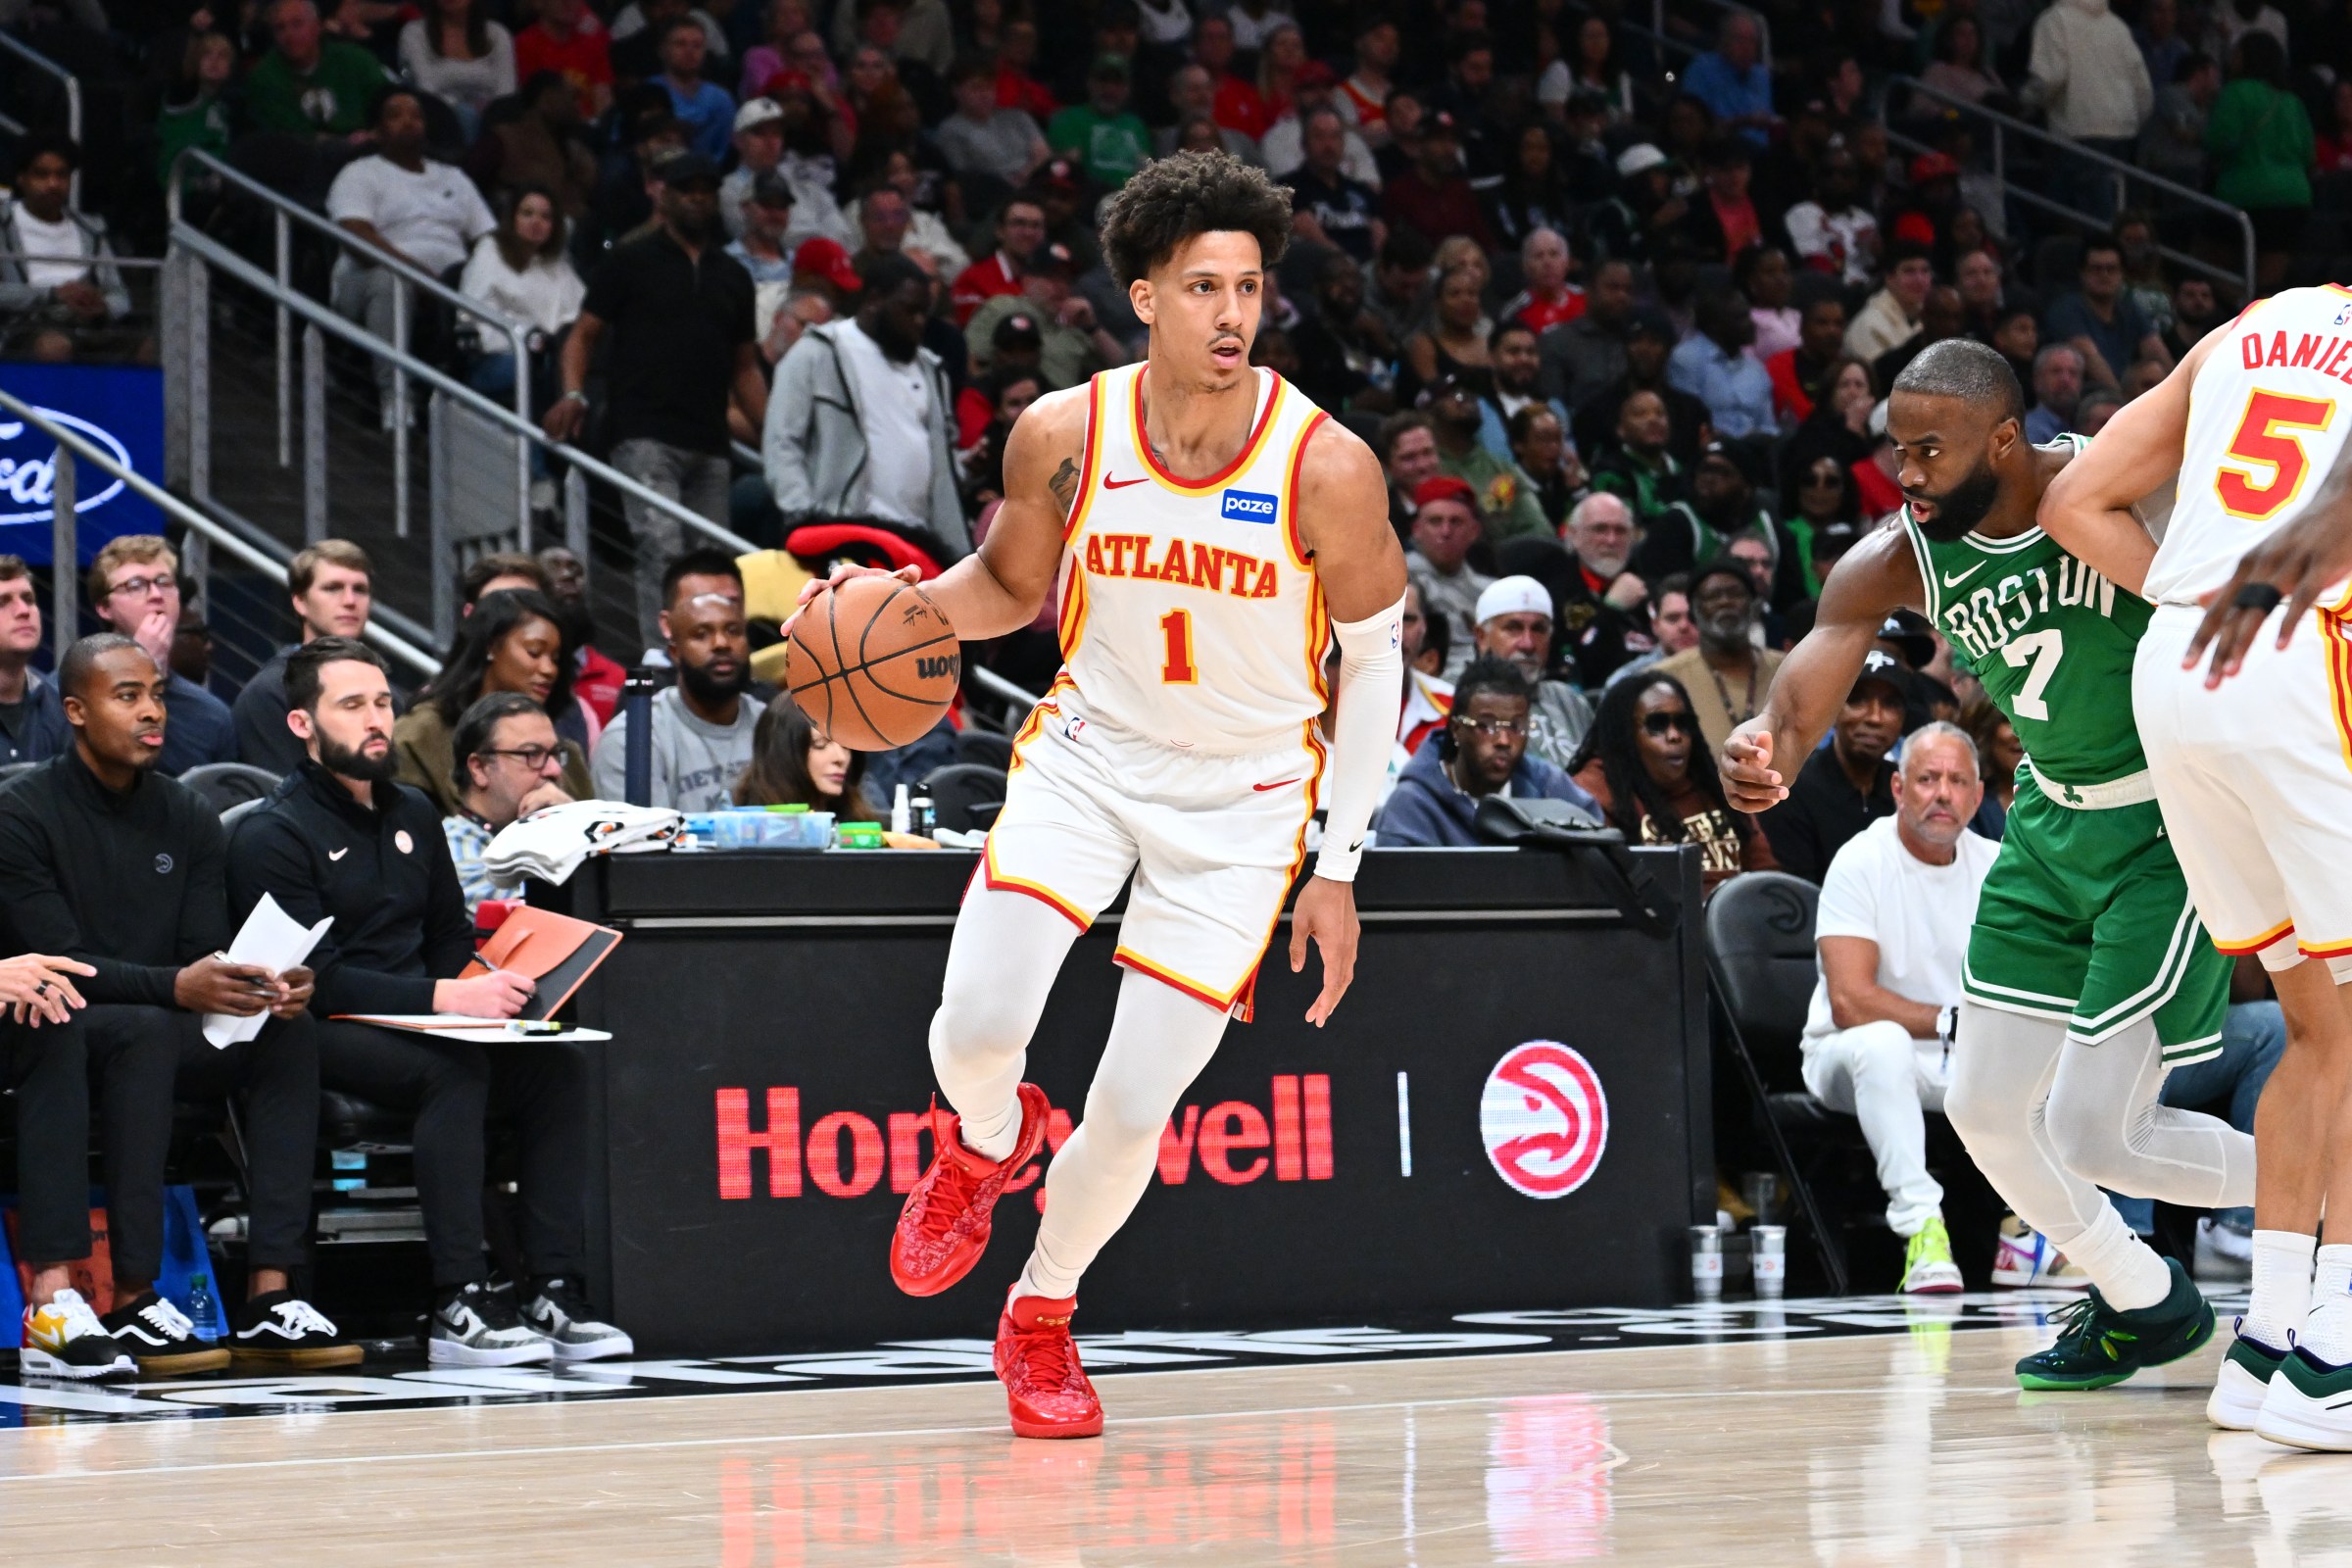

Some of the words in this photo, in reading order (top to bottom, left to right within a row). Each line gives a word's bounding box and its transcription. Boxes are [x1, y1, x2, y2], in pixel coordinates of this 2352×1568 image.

[2213, 386, 2337, 521] 5
[1225, 496, 1274, 515] paze
[1086, 532, 1279, 600] ATLANTA
[1158, 607, 1199, 685] 1
[2000, 628, 2064, 721] 7
